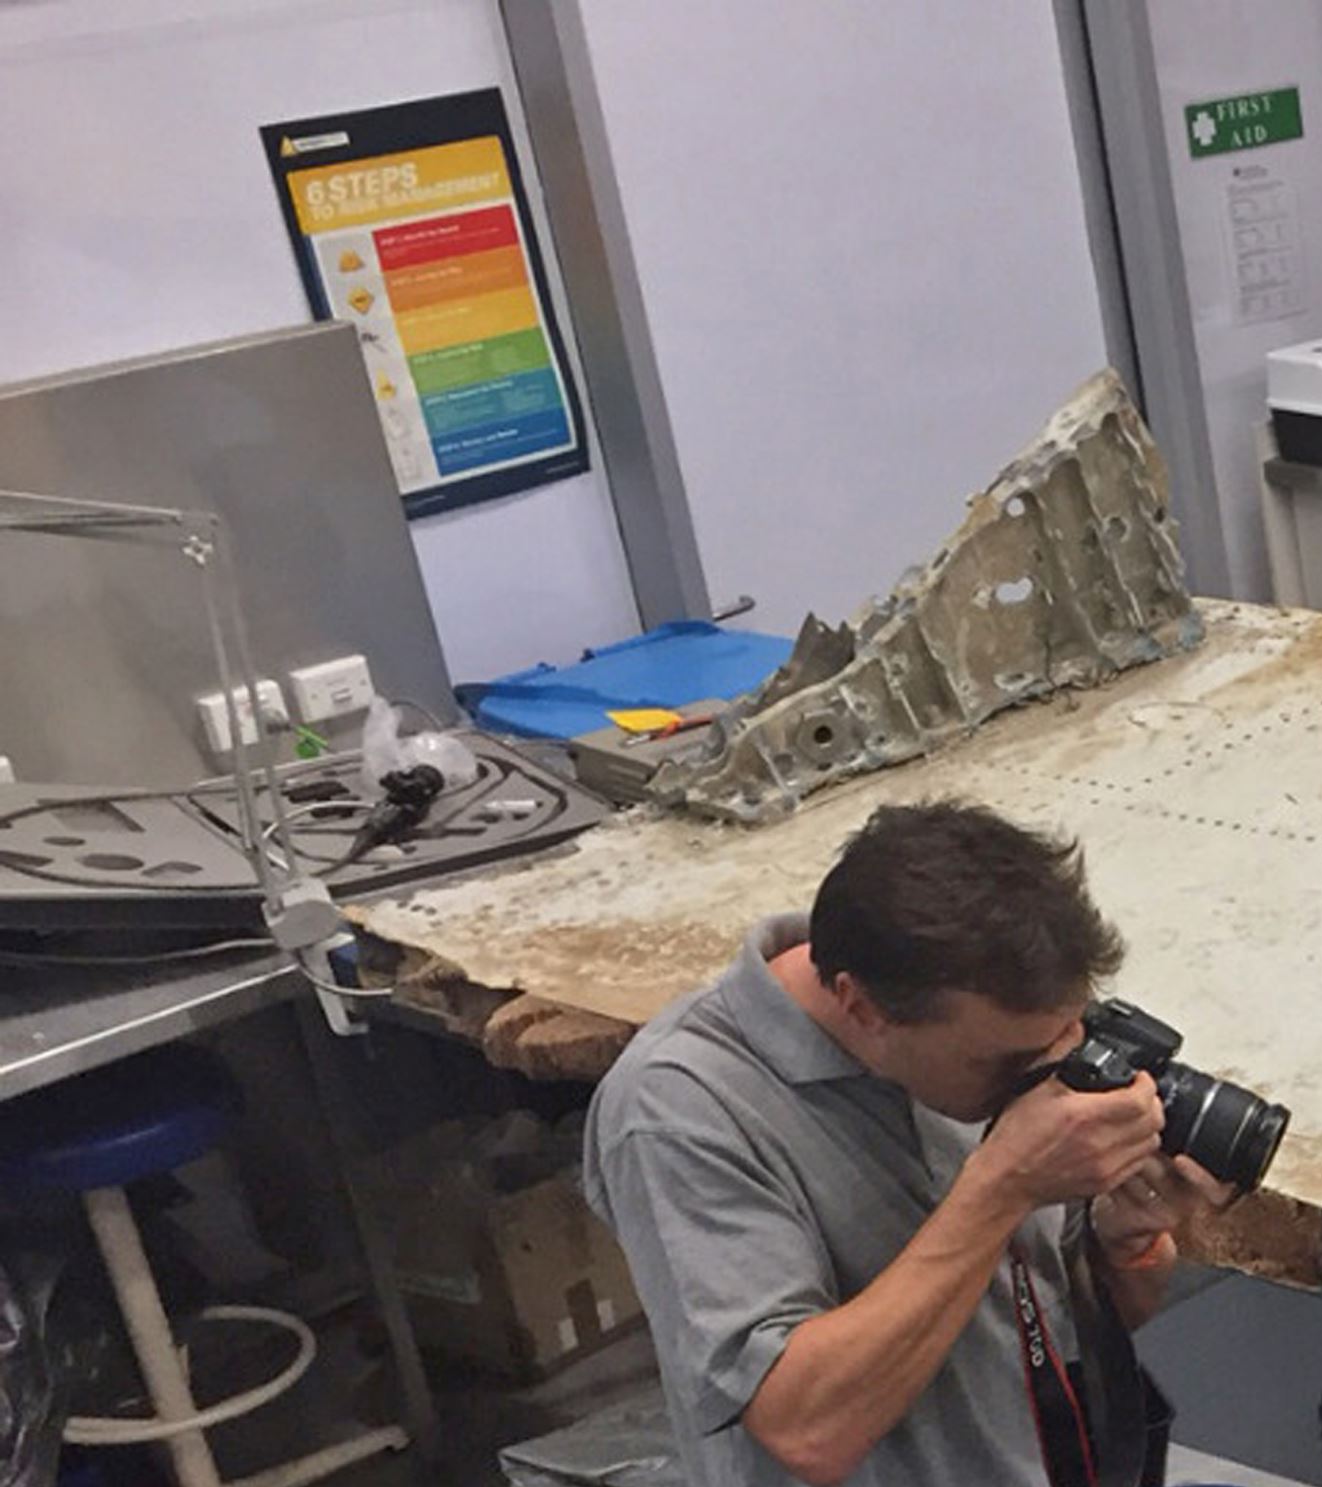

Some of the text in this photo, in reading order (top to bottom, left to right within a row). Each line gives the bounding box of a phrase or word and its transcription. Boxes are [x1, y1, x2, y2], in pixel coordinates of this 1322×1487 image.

[1216, 95, 1271, 122] FIRST
[1231, 124, 1268, 147] AID
[306, 162, 418, 206] 6 STEPS
[310, 203, 335, 221] TO
